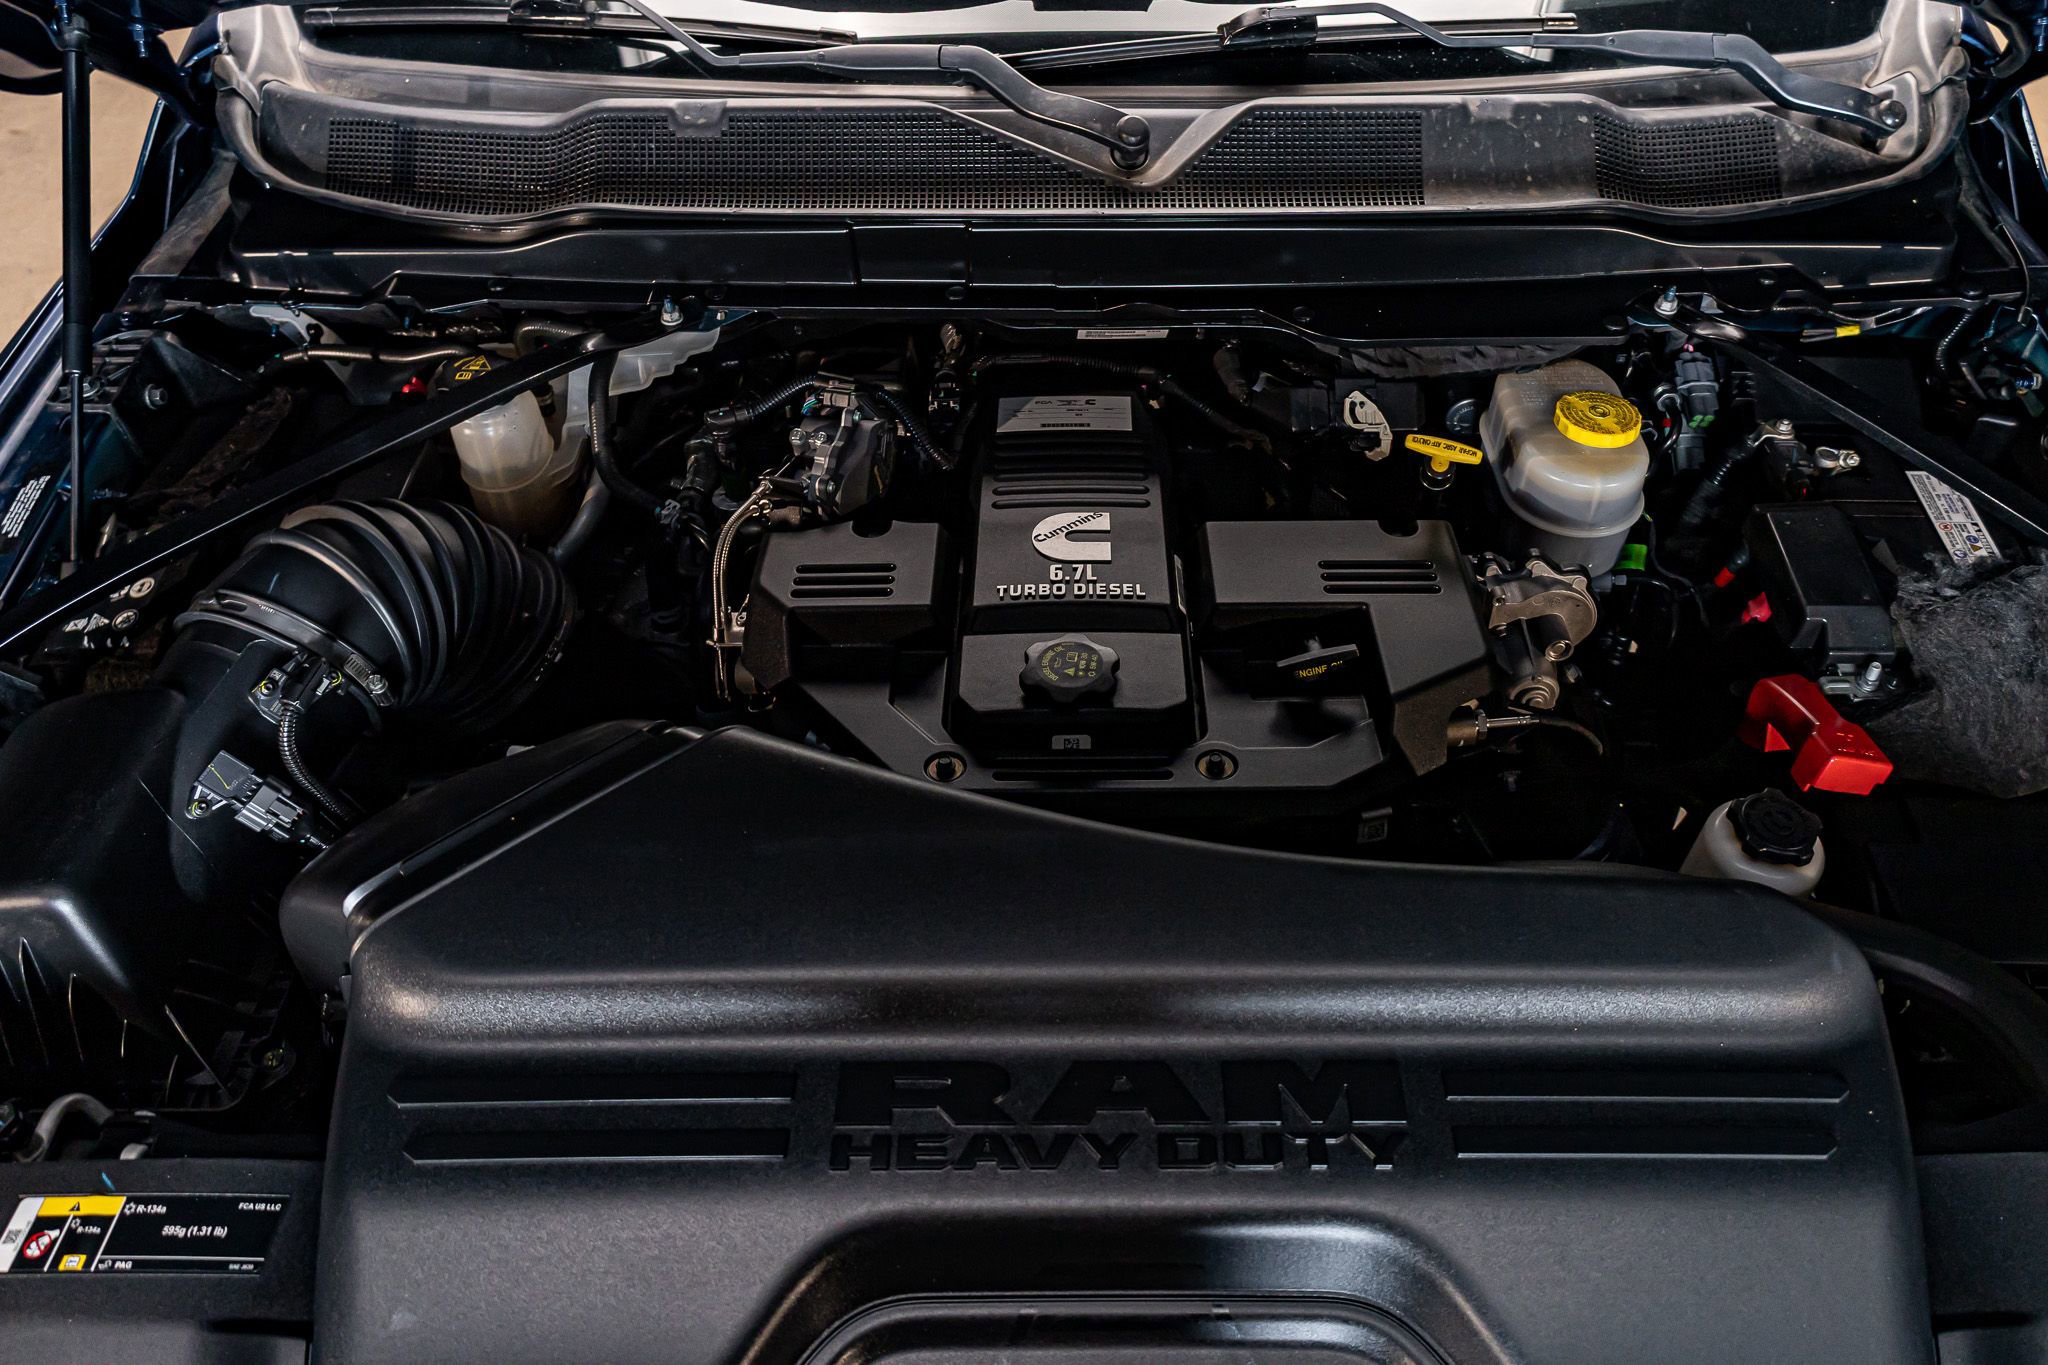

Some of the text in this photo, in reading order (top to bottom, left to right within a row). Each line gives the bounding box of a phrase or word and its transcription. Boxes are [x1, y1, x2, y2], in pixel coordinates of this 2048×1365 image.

[1033, 511, 1104, 542] Cummins
[1049, 564, 1097, 582] 6.7L
[997, 584, 1146, 598] TURBO DIESEL
[832, 1059, 1409, 1128] RAM
[828, 1132, 1409, 1172] HEAVY DUTY
[136, 1204, 167, 1214] R-134a
[238, 1202, 282, 1212] FCA US LLC
[161, 1225, 228, 1239] 595g (1.31 lb)
[114, 1260, 133, 1270] PAG
